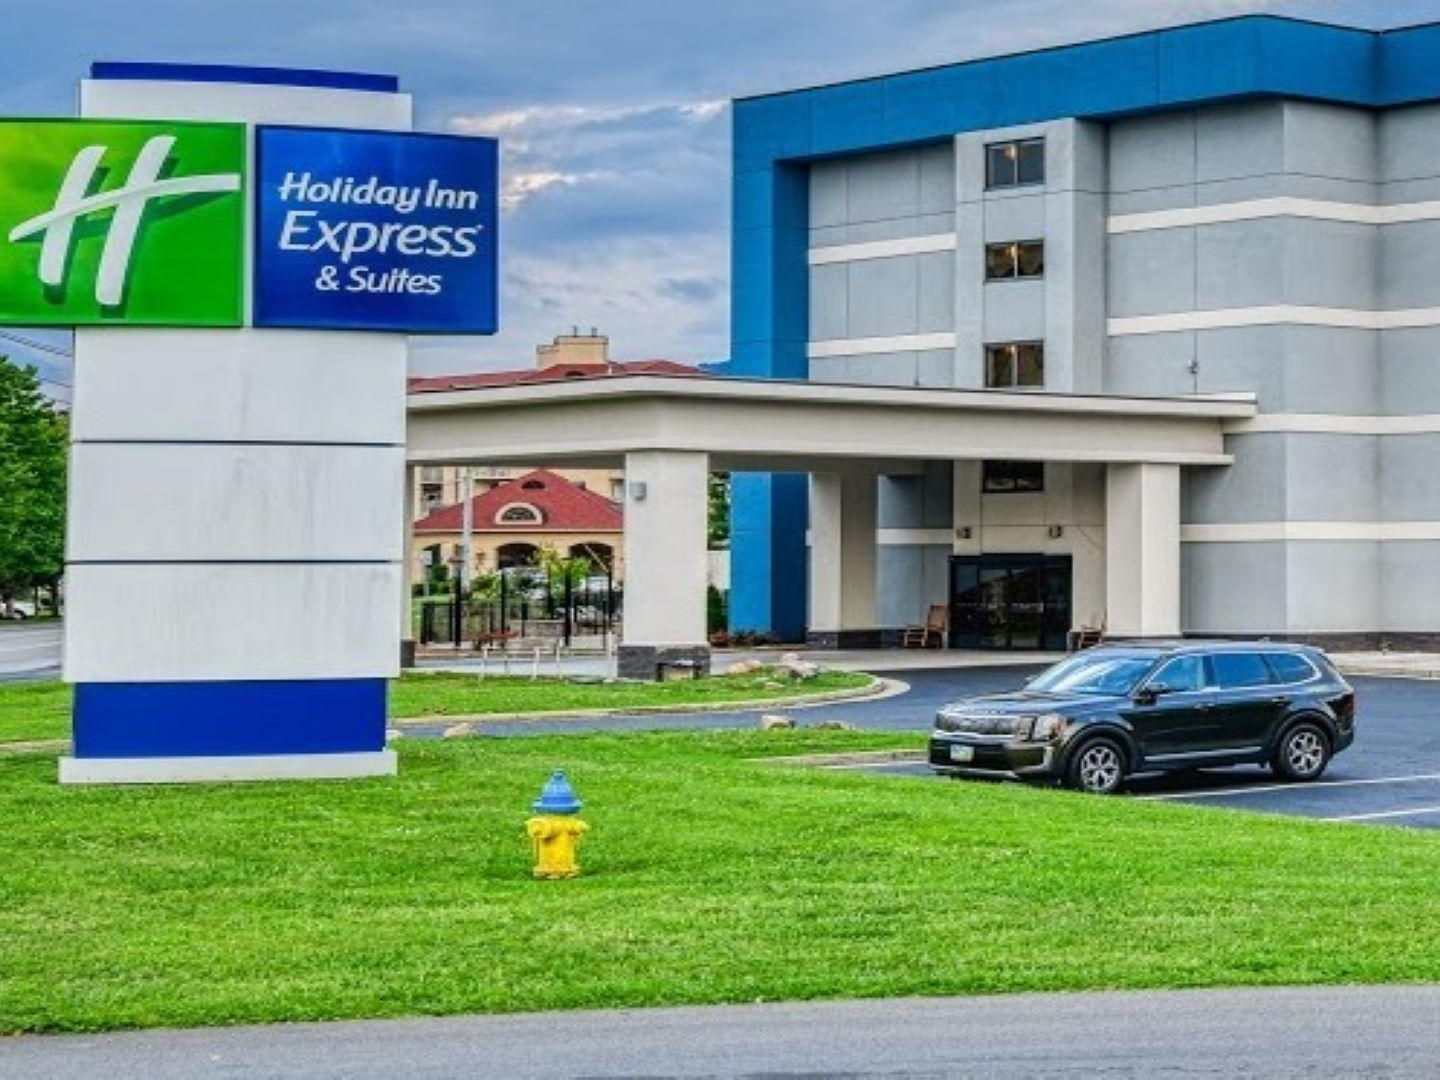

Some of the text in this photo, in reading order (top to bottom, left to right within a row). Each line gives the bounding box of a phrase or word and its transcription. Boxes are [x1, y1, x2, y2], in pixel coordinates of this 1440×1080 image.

[278, 171, 479, 214] Holiday Inn
[278, 210, 479, 262] Express
[314, 265, 443, 294] & Suites
